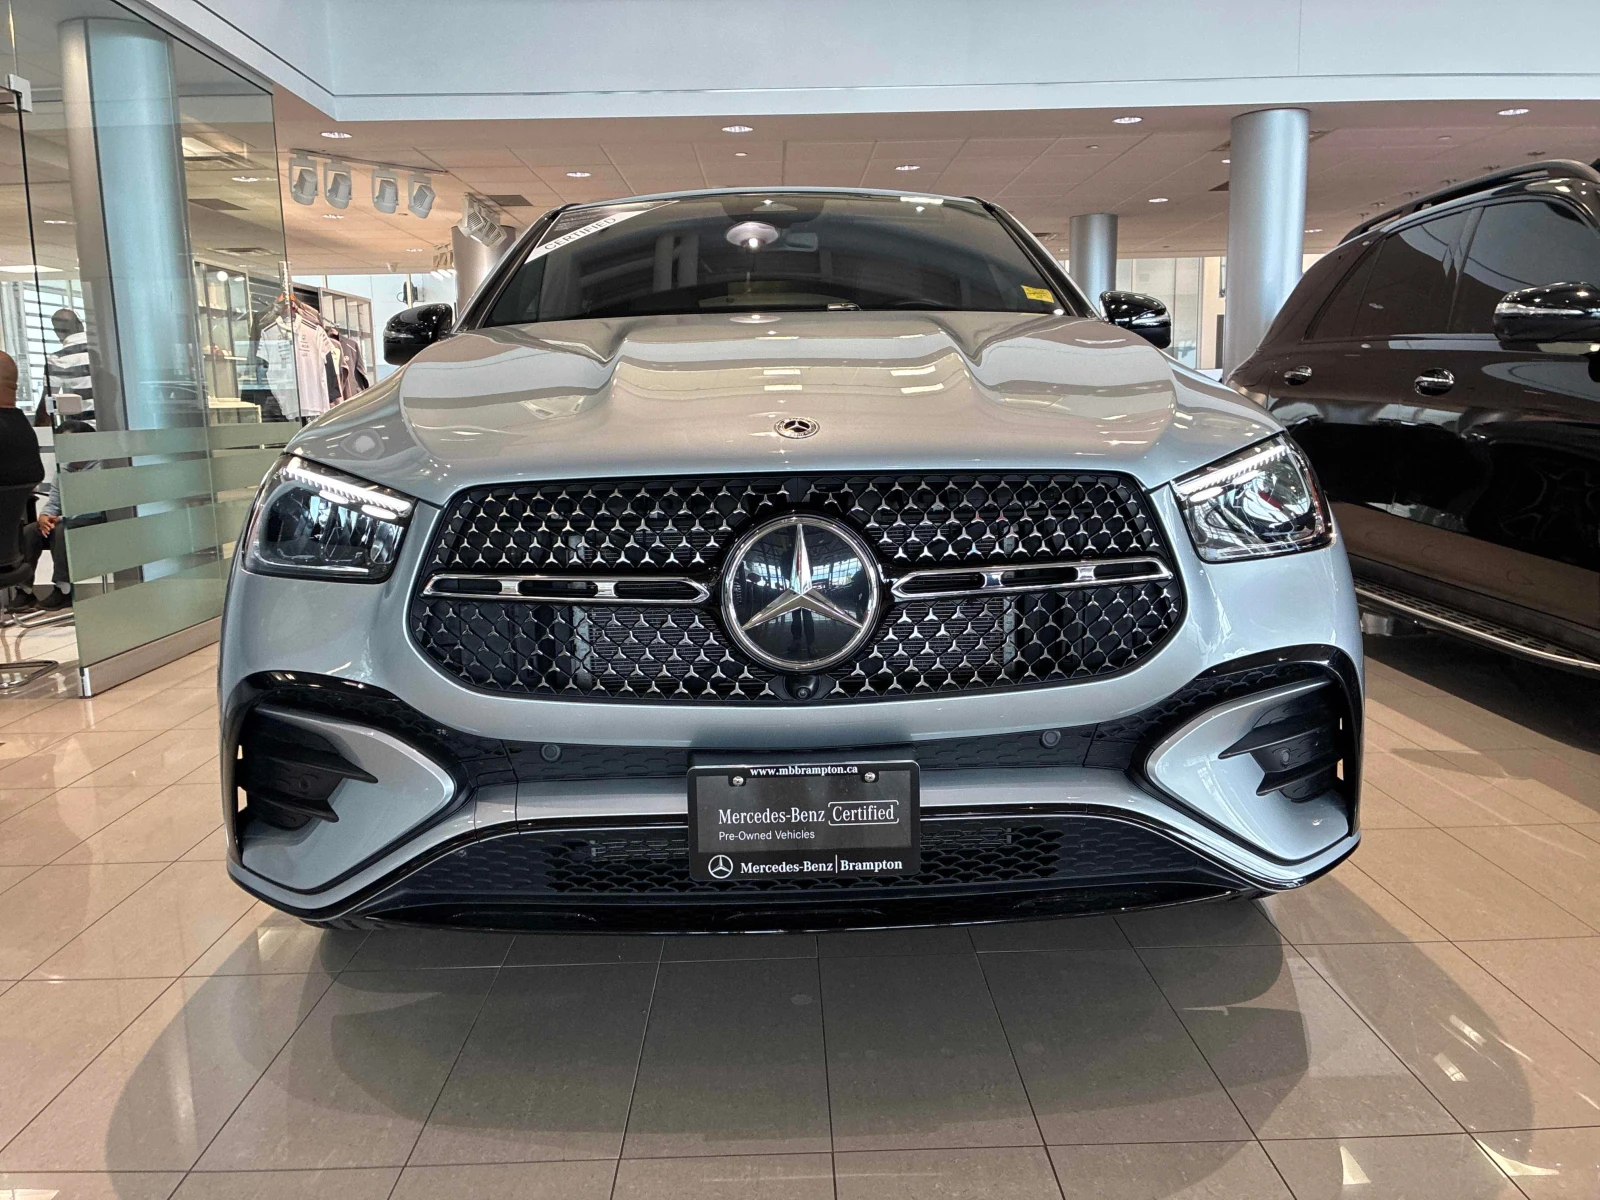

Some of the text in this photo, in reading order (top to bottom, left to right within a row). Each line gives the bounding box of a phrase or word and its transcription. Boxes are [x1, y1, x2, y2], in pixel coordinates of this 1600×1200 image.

[544, 217, 616, 250] CERTIFIED
[750, 765, 858, 776] www.mbbrampton.ca
[719, 805, 895, 824] Mercedes-Benz Certified
[719, 829, 815, 840] Pre-Owned Vehicles
[740, 859, 902, 873] Mercedes-Benz Brampton
